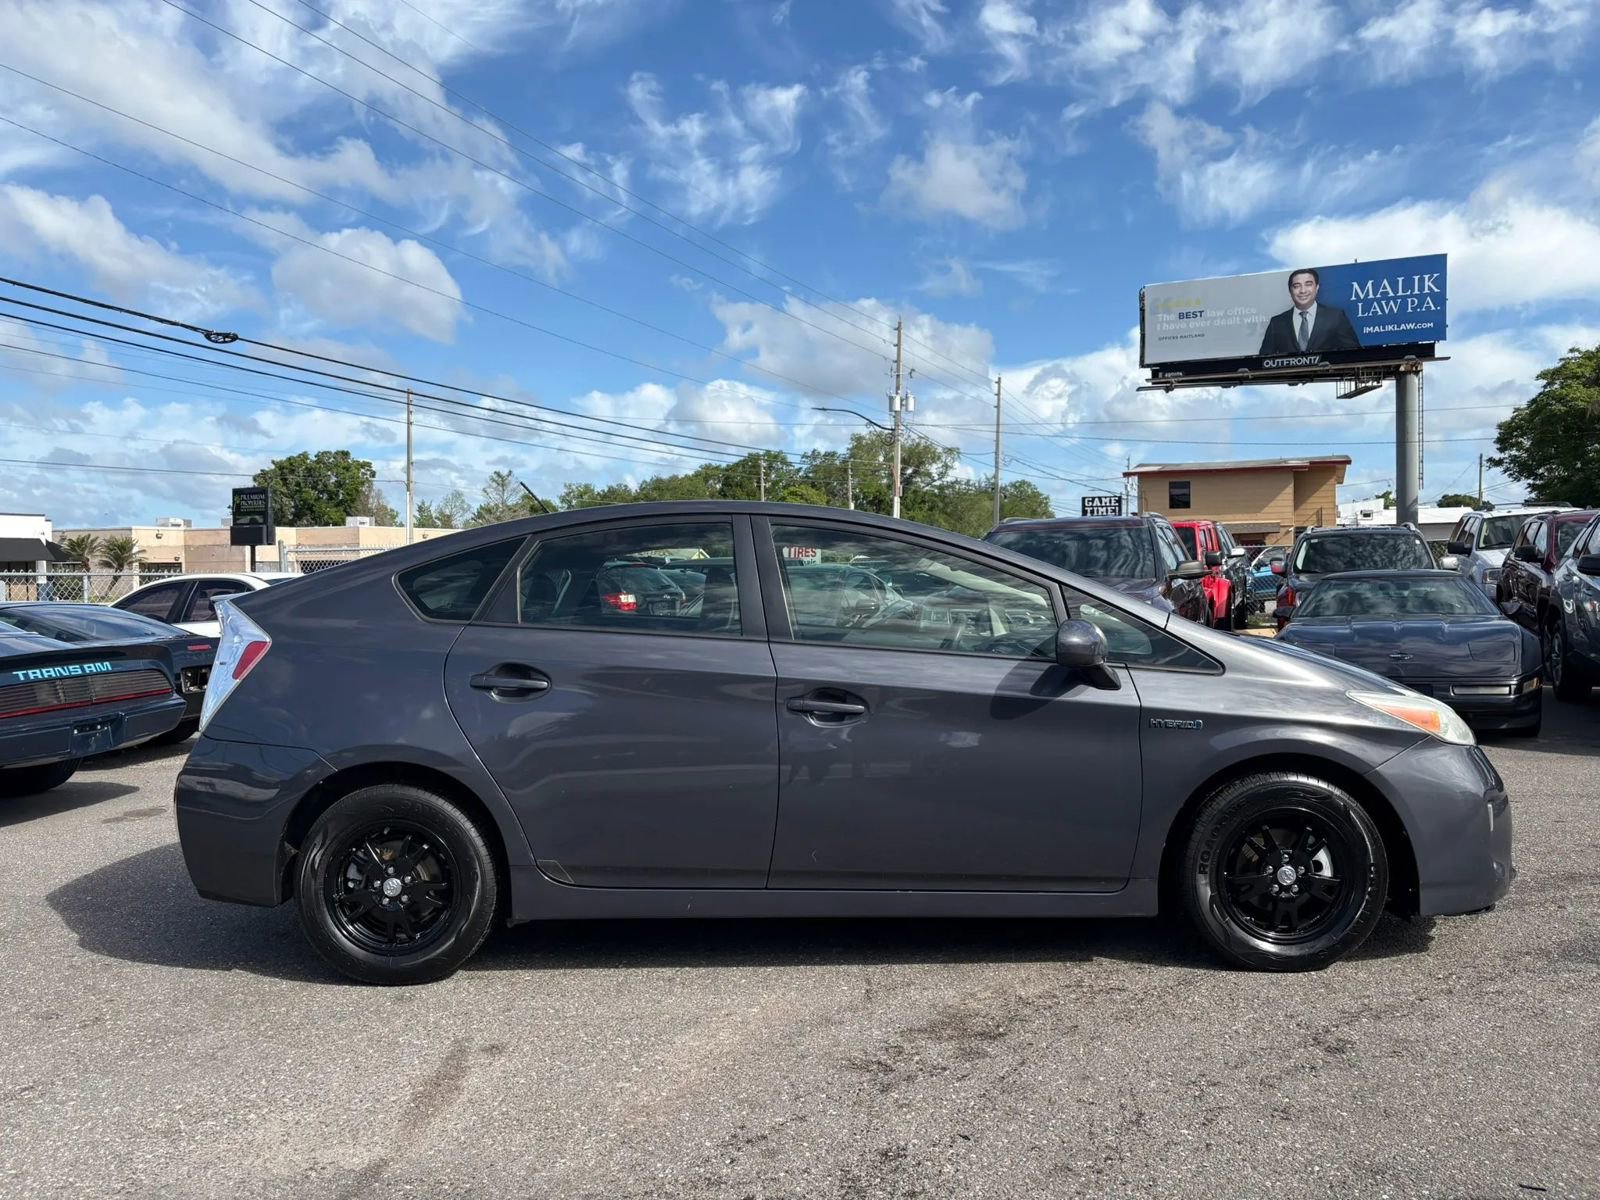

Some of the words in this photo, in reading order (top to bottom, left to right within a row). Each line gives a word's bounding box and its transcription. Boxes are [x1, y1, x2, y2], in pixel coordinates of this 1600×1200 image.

[1350, 272, 1440, 300] MALIK
[1178, 310, 1205, 320] BEST
[1206, 308, 1226, 318] law
[1227, 305, 1257, 316] office
[1357, 298, 1402, 317] LAW
[1406, 296, 1441, 313] P.A.
[1162, 321, 1186, 331] have
[1189, 319, 1210, 329] ever
[1214, 316, 1240, 327] dealt
[1085, 497, 1119, 506] GAME
[1085, 507, 1119, 516] TIME!
[788, 546, 816, 558] TIRES
[12, 665, 82, 681] TRANS
[83, 661, 112, 673] AM
[1149, 718, 1194, 729] HYBRID
